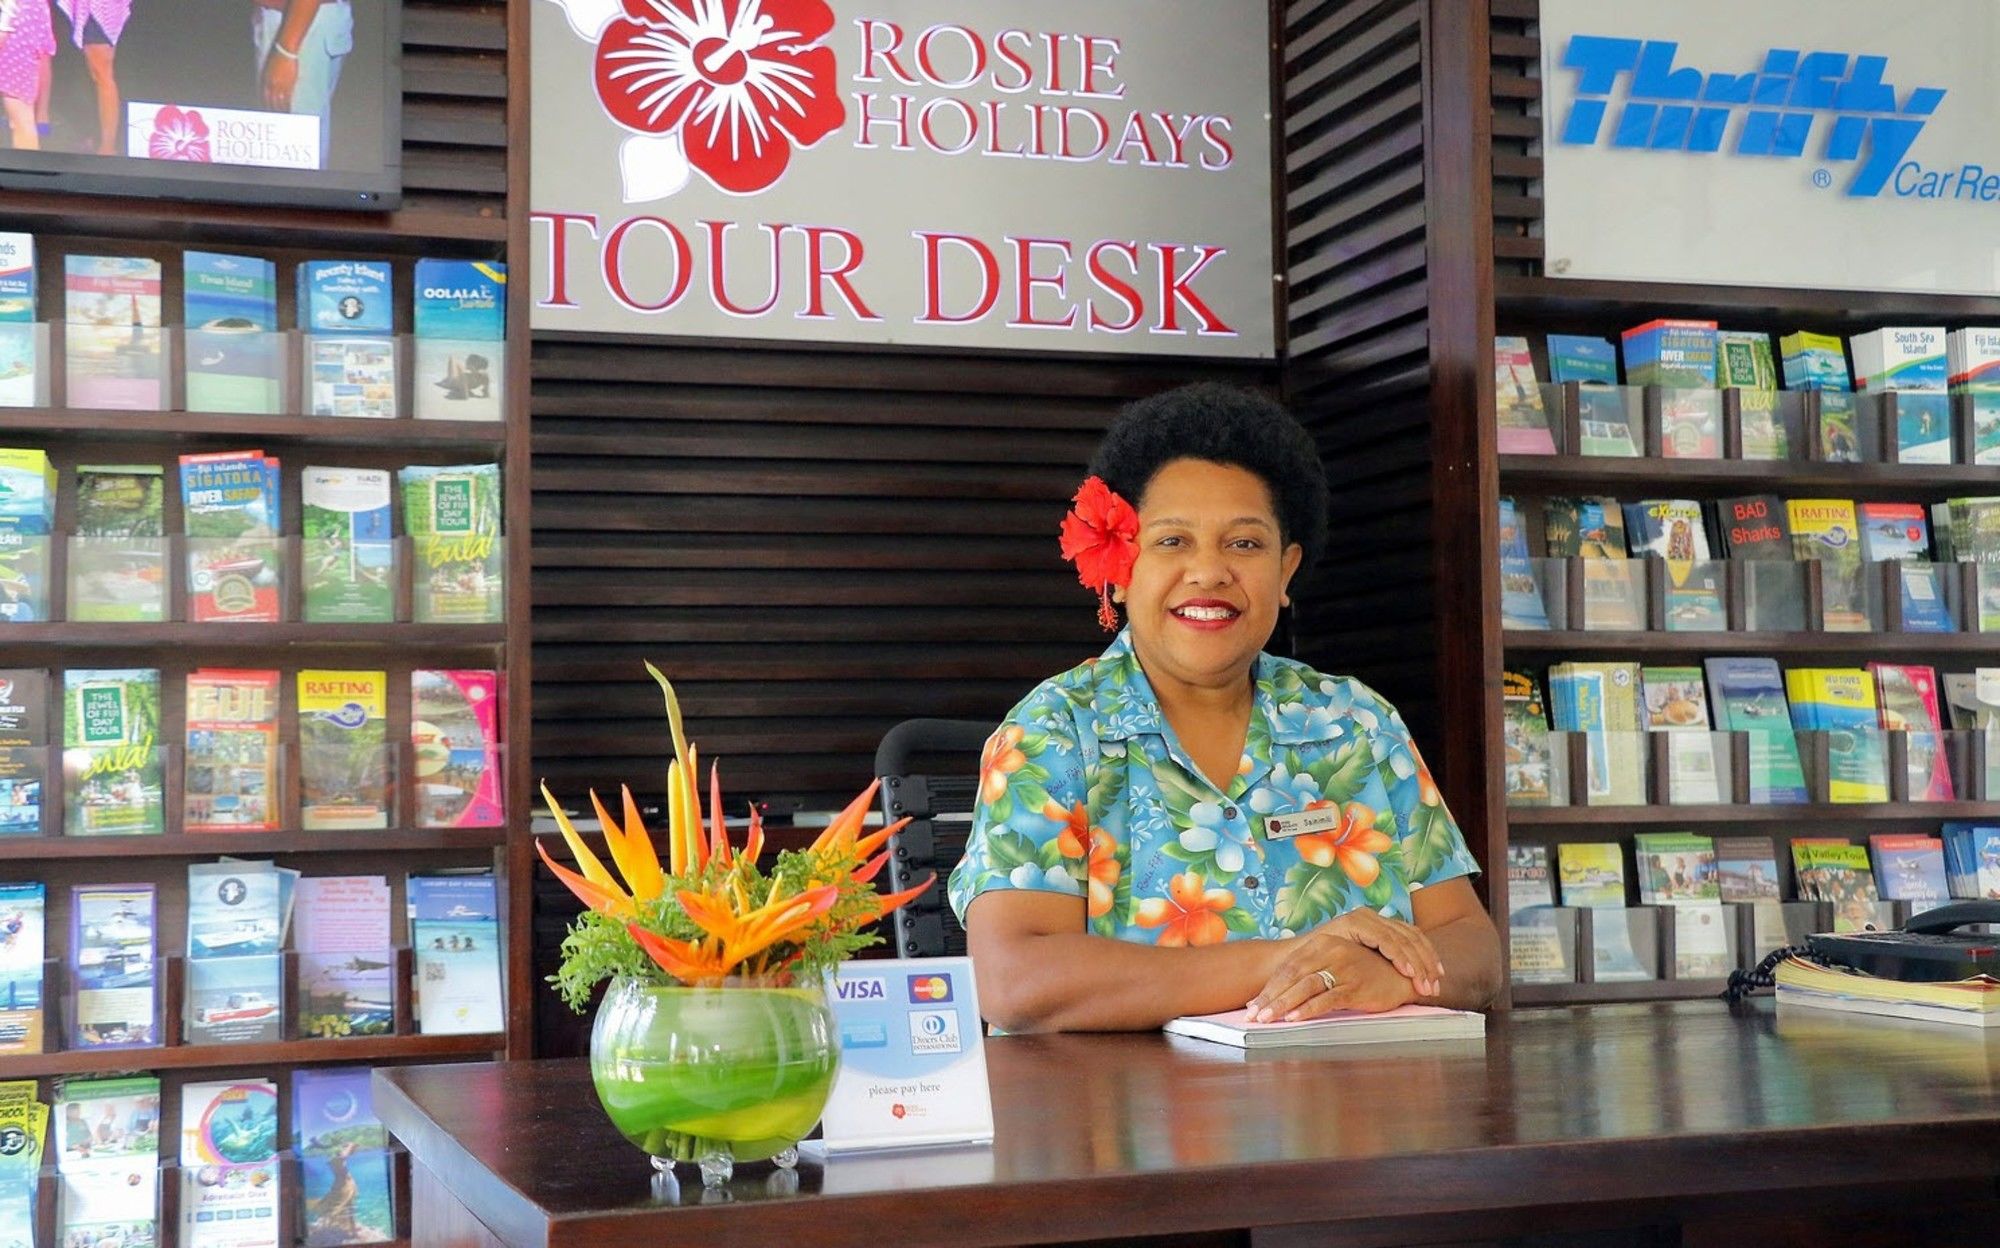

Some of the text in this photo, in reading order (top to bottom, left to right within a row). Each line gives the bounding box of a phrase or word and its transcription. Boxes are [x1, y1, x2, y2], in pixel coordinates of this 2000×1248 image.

[853, 18, 1127, 98] ROSIE
[1561, 35, 1948, 197] Thrifty
[217, 119, 278, 142] ROSIE
[852, 91, 1235, 170] HOLIDAYS
[216, 139, 313, 163] HOLIDAYS
[1894, 160, 2000, 202] Car Re
[530, 211, 1239, 336] TOUR DESK
[1895, 332, 1934, 344] South Sea
[1902, 344, 1927, 355] Island
[1733, 501, 1768, 521] BAD
[1801, 507, 1850, 519] RAFTING
[1730, 523, 1782, 545] Sharks
[305, 681, 374, 694] RAFTING
[836, 981, 884, 999] VISA
[868, 1081, 942, 1098] please pay here
